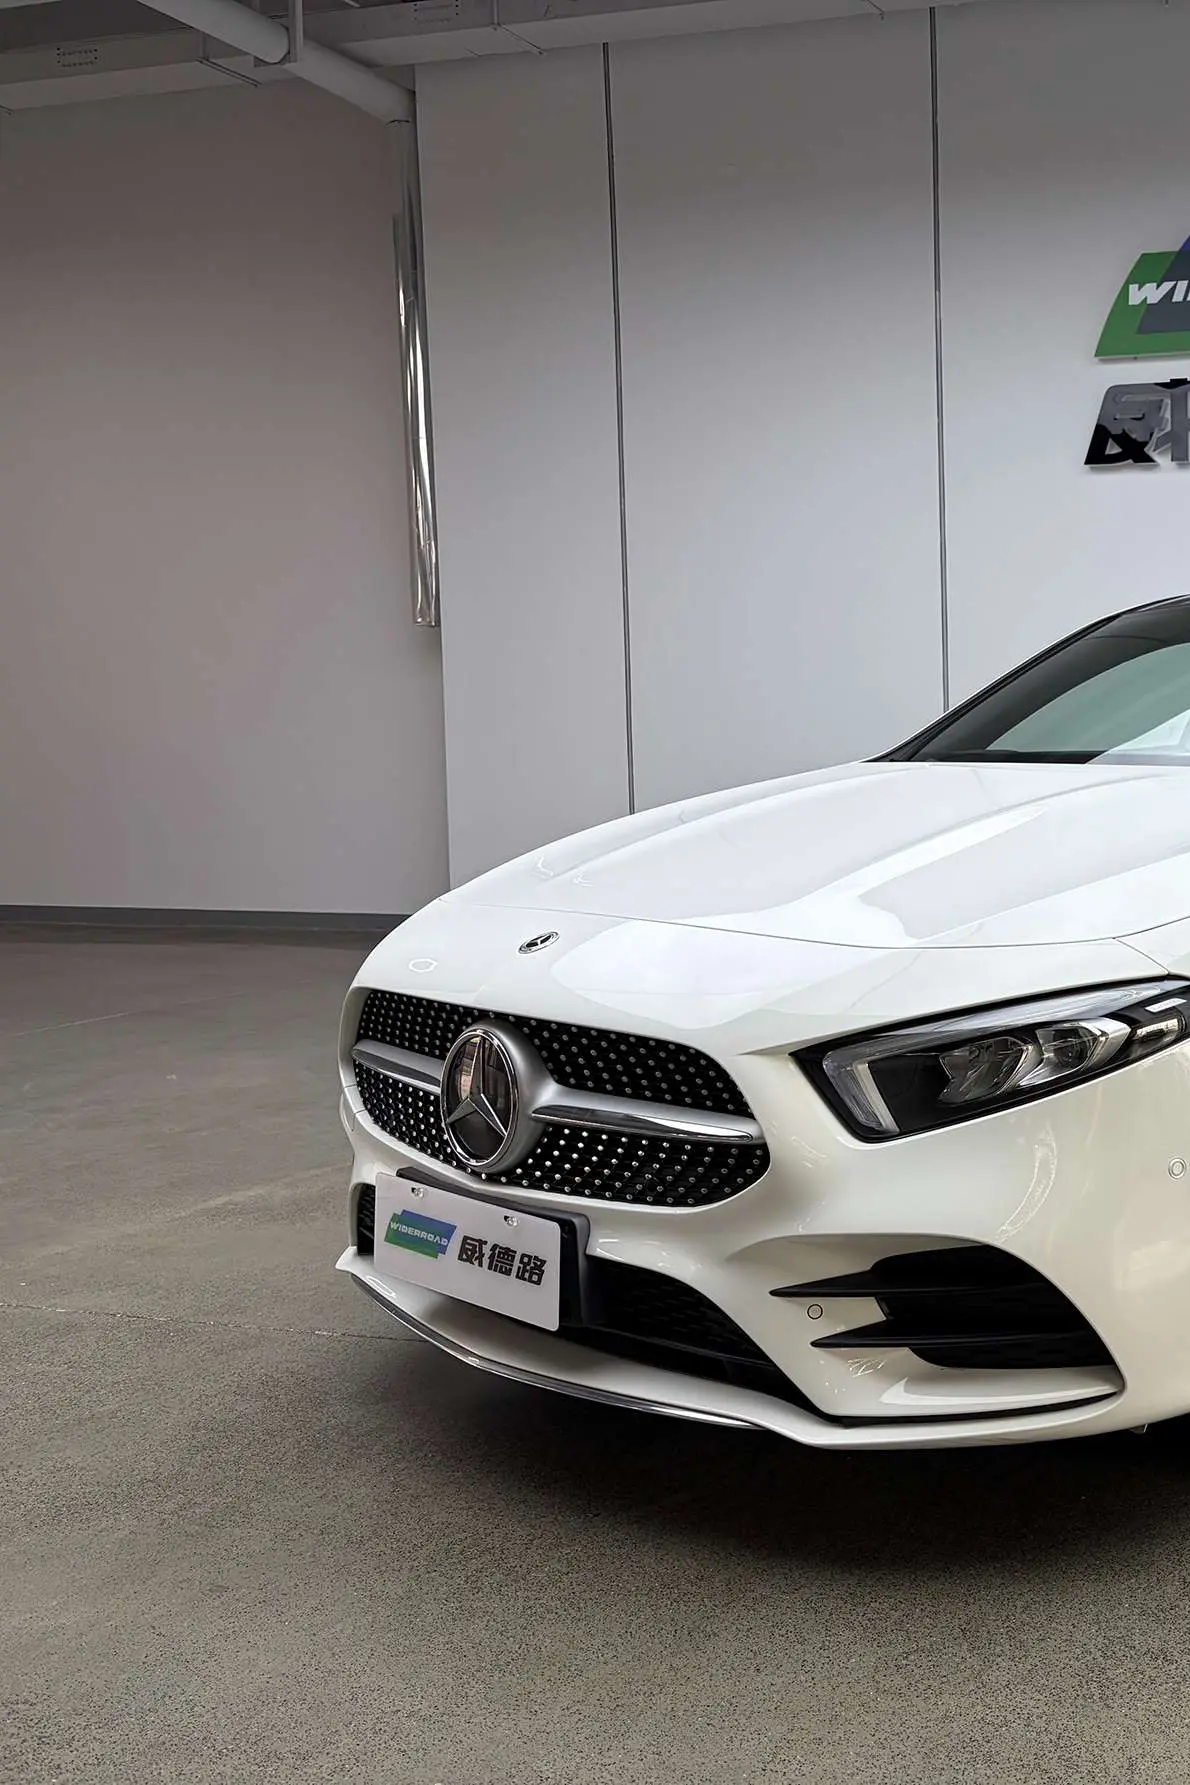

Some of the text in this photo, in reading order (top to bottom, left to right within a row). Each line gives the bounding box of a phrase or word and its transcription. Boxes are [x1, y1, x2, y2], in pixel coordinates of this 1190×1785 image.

[390, 1221, 449, 1246] WIDERROAD
[457, 1235, 547, 1286] 威德路
